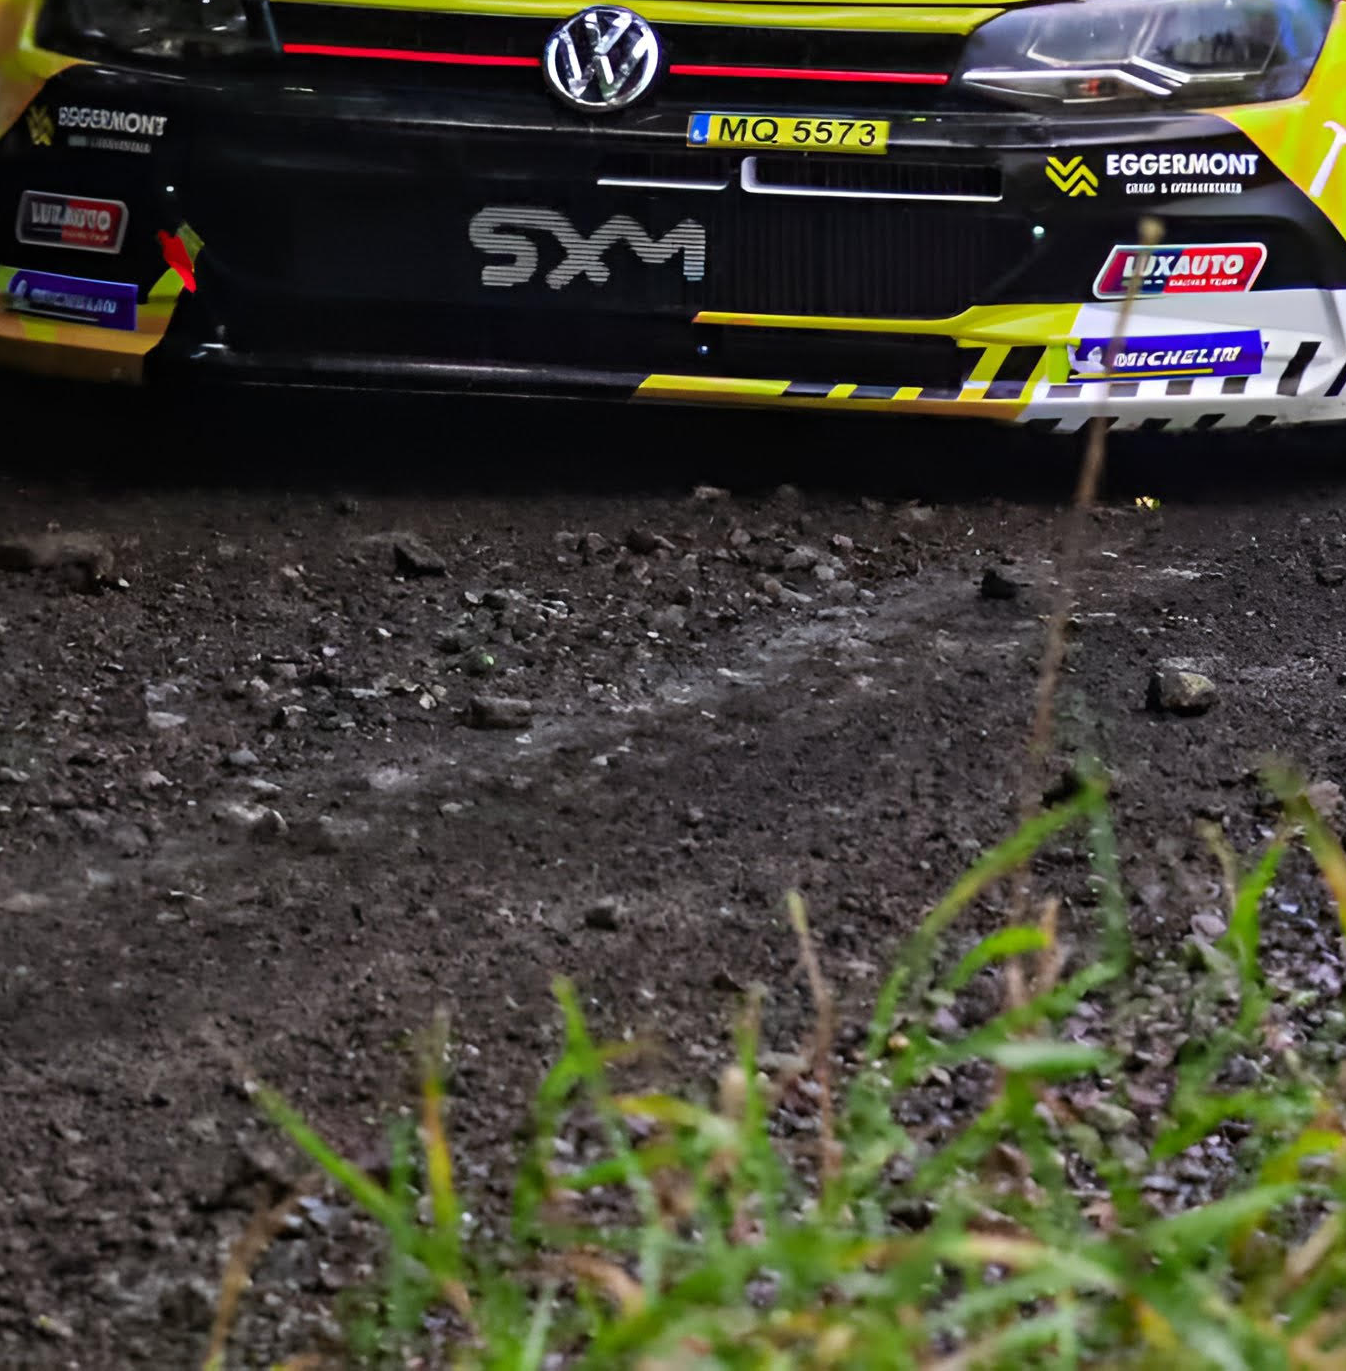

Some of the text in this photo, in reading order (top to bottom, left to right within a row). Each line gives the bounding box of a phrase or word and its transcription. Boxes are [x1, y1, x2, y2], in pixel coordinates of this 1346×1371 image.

[718, 117, 877, 147] MQ 5573
[1106, 152, 1259, 176] EGGERMONT
[467, 206, 706, 290] SXM
[1122, 254, 1245, 279] LUXAUTO
